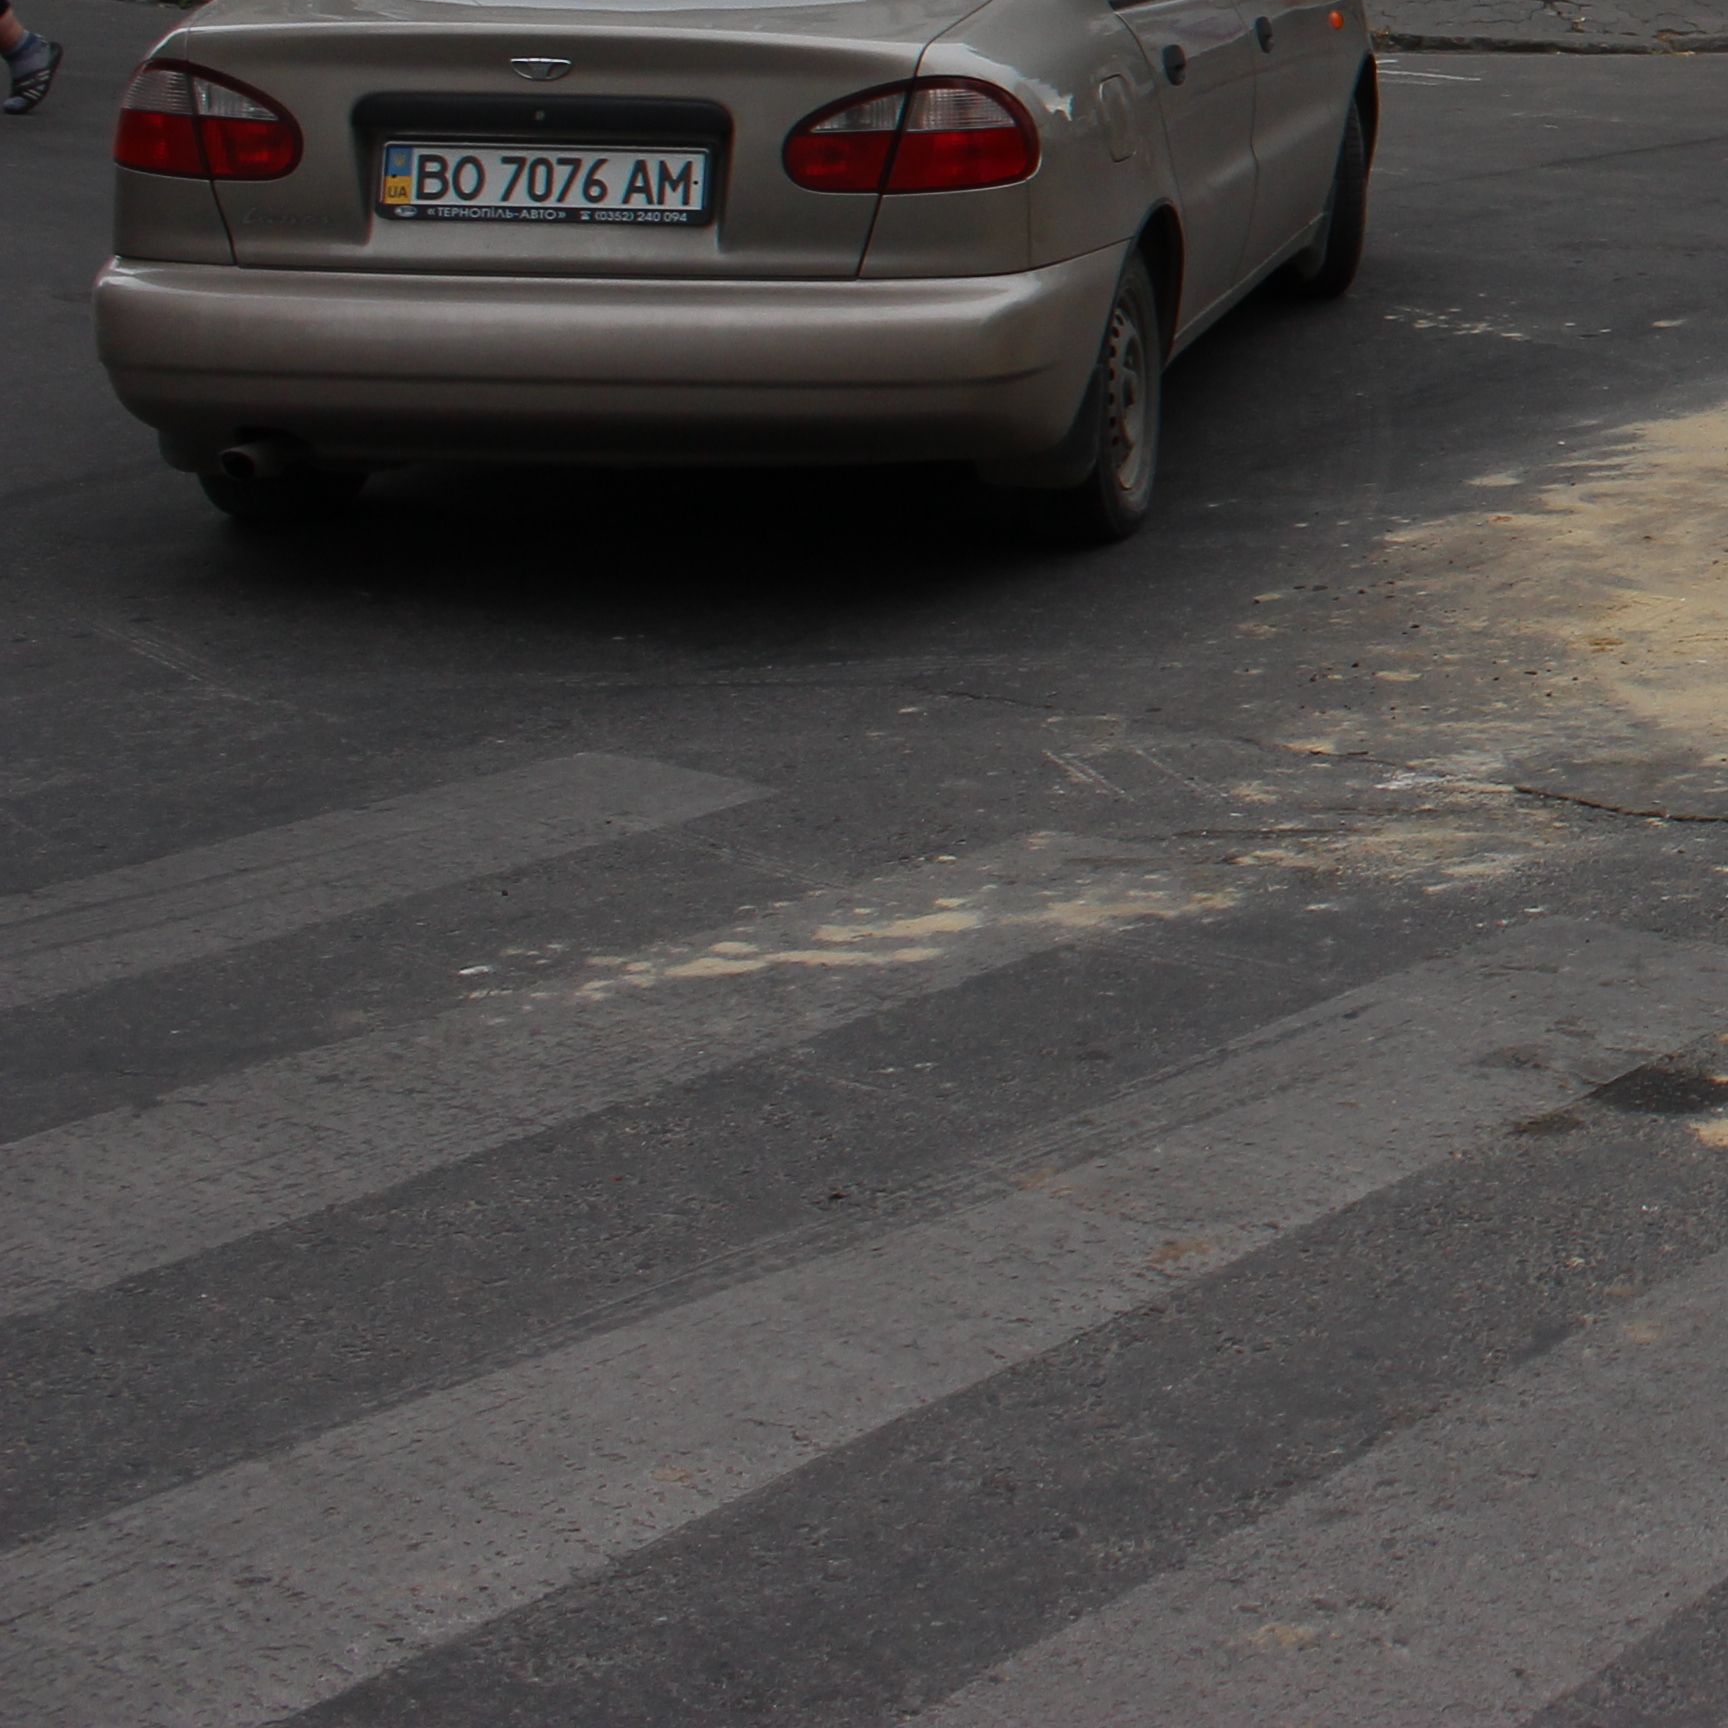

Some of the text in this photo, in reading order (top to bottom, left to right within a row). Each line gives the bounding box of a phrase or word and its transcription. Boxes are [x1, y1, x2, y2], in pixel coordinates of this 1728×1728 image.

[414, 153, 695, 207] BO 7076 AM
[387, 185, 408, 200] UA
[594, 209, 635, 223] (0352)
[637, 209, 660, 222] 240
[662, 210, 688, 223] 094
